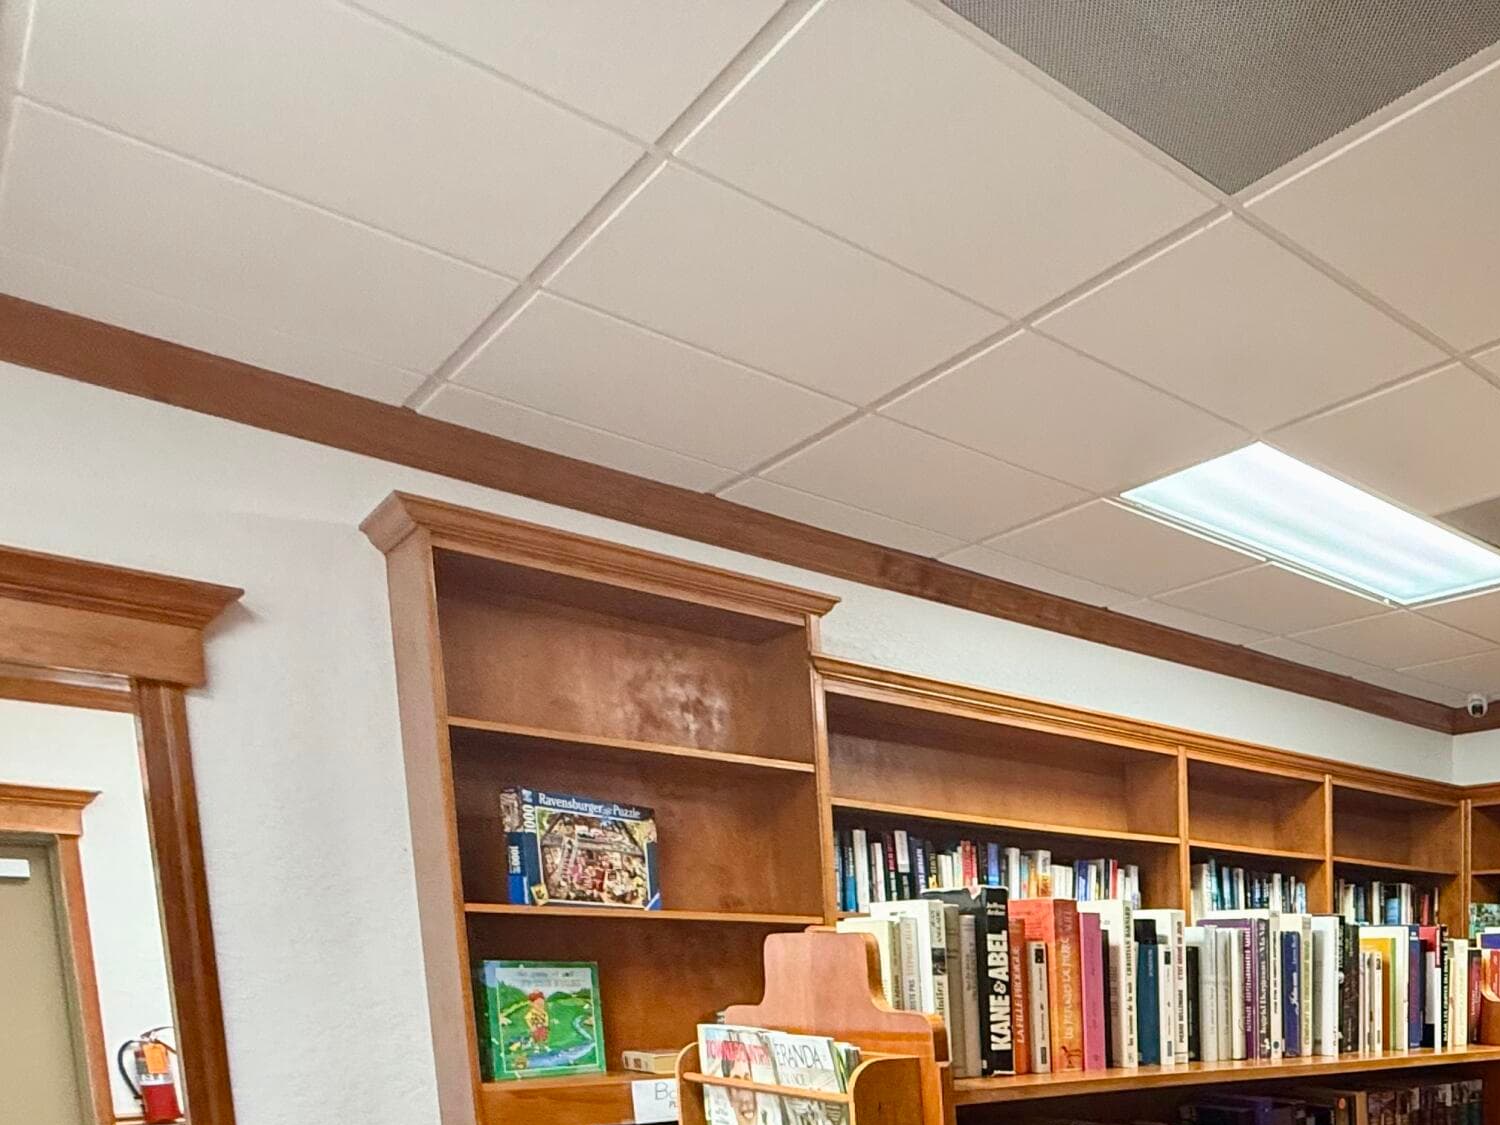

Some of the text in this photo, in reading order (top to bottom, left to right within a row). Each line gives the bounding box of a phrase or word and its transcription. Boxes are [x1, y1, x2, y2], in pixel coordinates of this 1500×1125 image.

[522, 804, 536, 833] 1000
[538, 792, 641, 819] Ravensburger Puzzle
[986, 930, 1009, 982] ABEL
[993, 981, 1007, 994] &
[988, 994, 1012, 1051] KANE
[1014, 999, 1024, 1025] FILLE
[1016, 1026, 1025, 1044] LA
[774, 1042, 824, 1073] ERANDA
